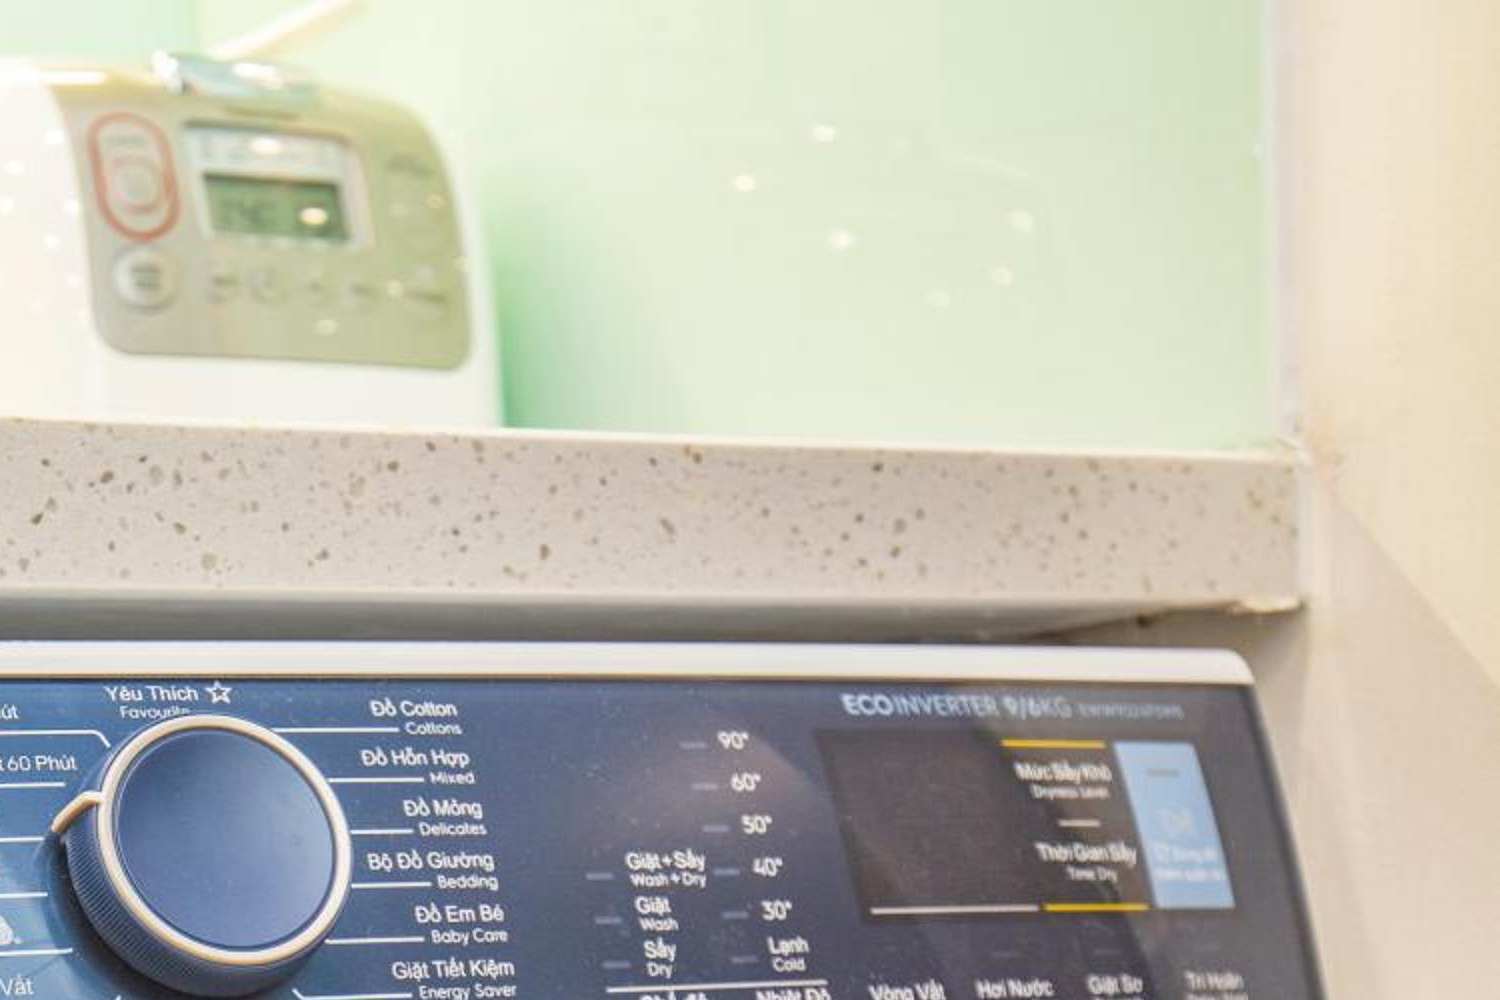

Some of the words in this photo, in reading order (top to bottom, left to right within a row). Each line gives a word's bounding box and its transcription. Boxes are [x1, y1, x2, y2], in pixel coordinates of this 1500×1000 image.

[105, 684, 143, 702] Yêu
[146, 683, 199, 702] Thích
[370, 698, 397, 717] Đồ
[401, 700, 458, 717] Cotton
[405, 721, 463, 736] Cottons
[7, 756, 31, 772] 60
[35, 754, 78, 772] Phút
[361, 747, 388, 766] Đồ
[430, 771, 476, 785] Mixed
[403, 798, 430, 817] Đồ
[419, 822, 487, 837] Delicates
[368, 853, 393, 872] Bộ
[397, 850, 423, 869] Đồ
[437, 876, 499, 891] Bedding
[415, 902, 442, 923] Đồ
[445, 905, 476, 922] Em
[479, 903, 505, 922] Bé
[639, 917, 679, 932] Wash
[431, 929, 470, 946] Baby
[472, 928, 509, 943] Care
[767, 936, 810, 956] Lạnh
[391, 960, 430, 982] Giặt
[646, 962, 673, 978] Dry
[772, 957, 806, 972] Cold
[0, 973, 36, 997] Vắt
[474, 983, 517, 998] Saver
